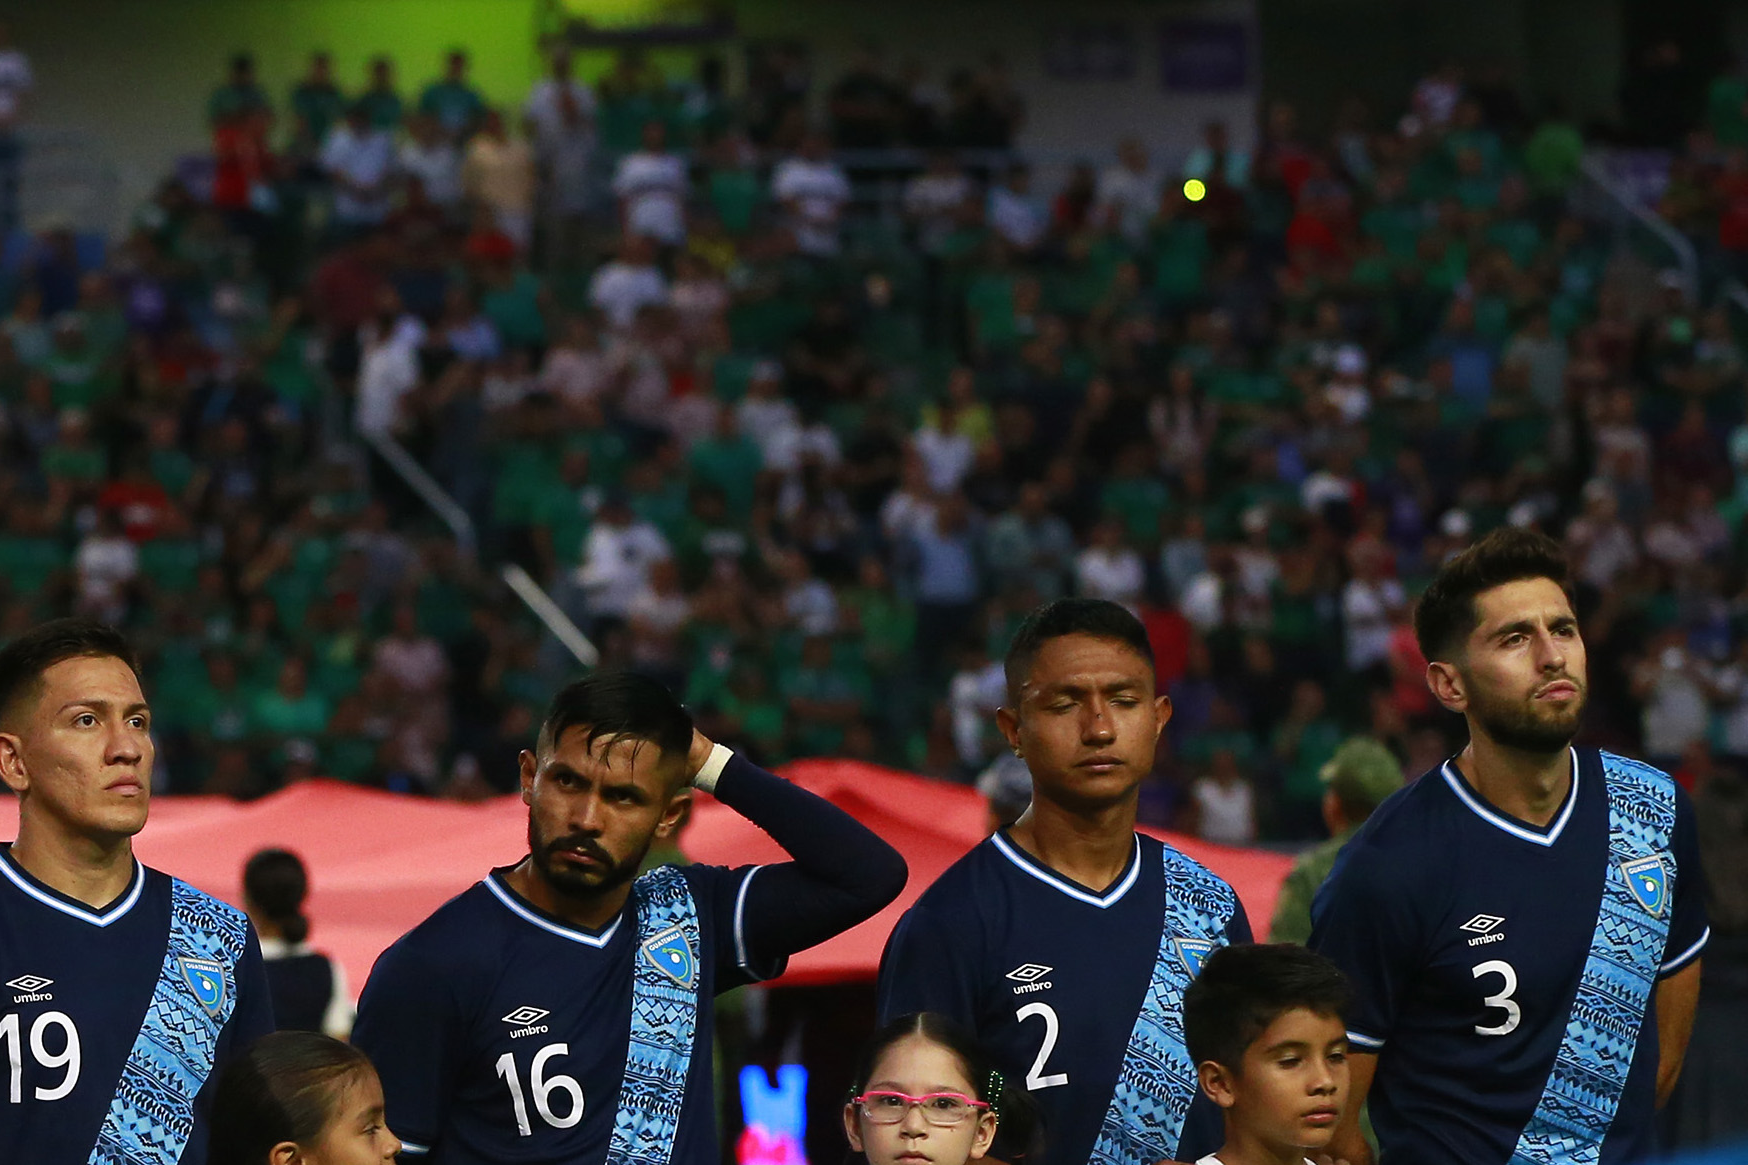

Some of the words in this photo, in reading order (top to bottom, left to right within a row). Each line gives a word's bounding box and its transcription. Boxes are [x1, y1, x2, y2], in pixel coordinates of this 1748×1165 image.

[1468, 932, 1505, 947] umbro
[1013, 981, 1052, 995] umbro
[13, 991, 53, 1003] umbro
[1471, 959, 1521, 1036] 3
[509, 1024, 549, 1039] umbro
[1015, 1001, 1069, 1091] 2
[495, 1042, 585, 1137] 16
